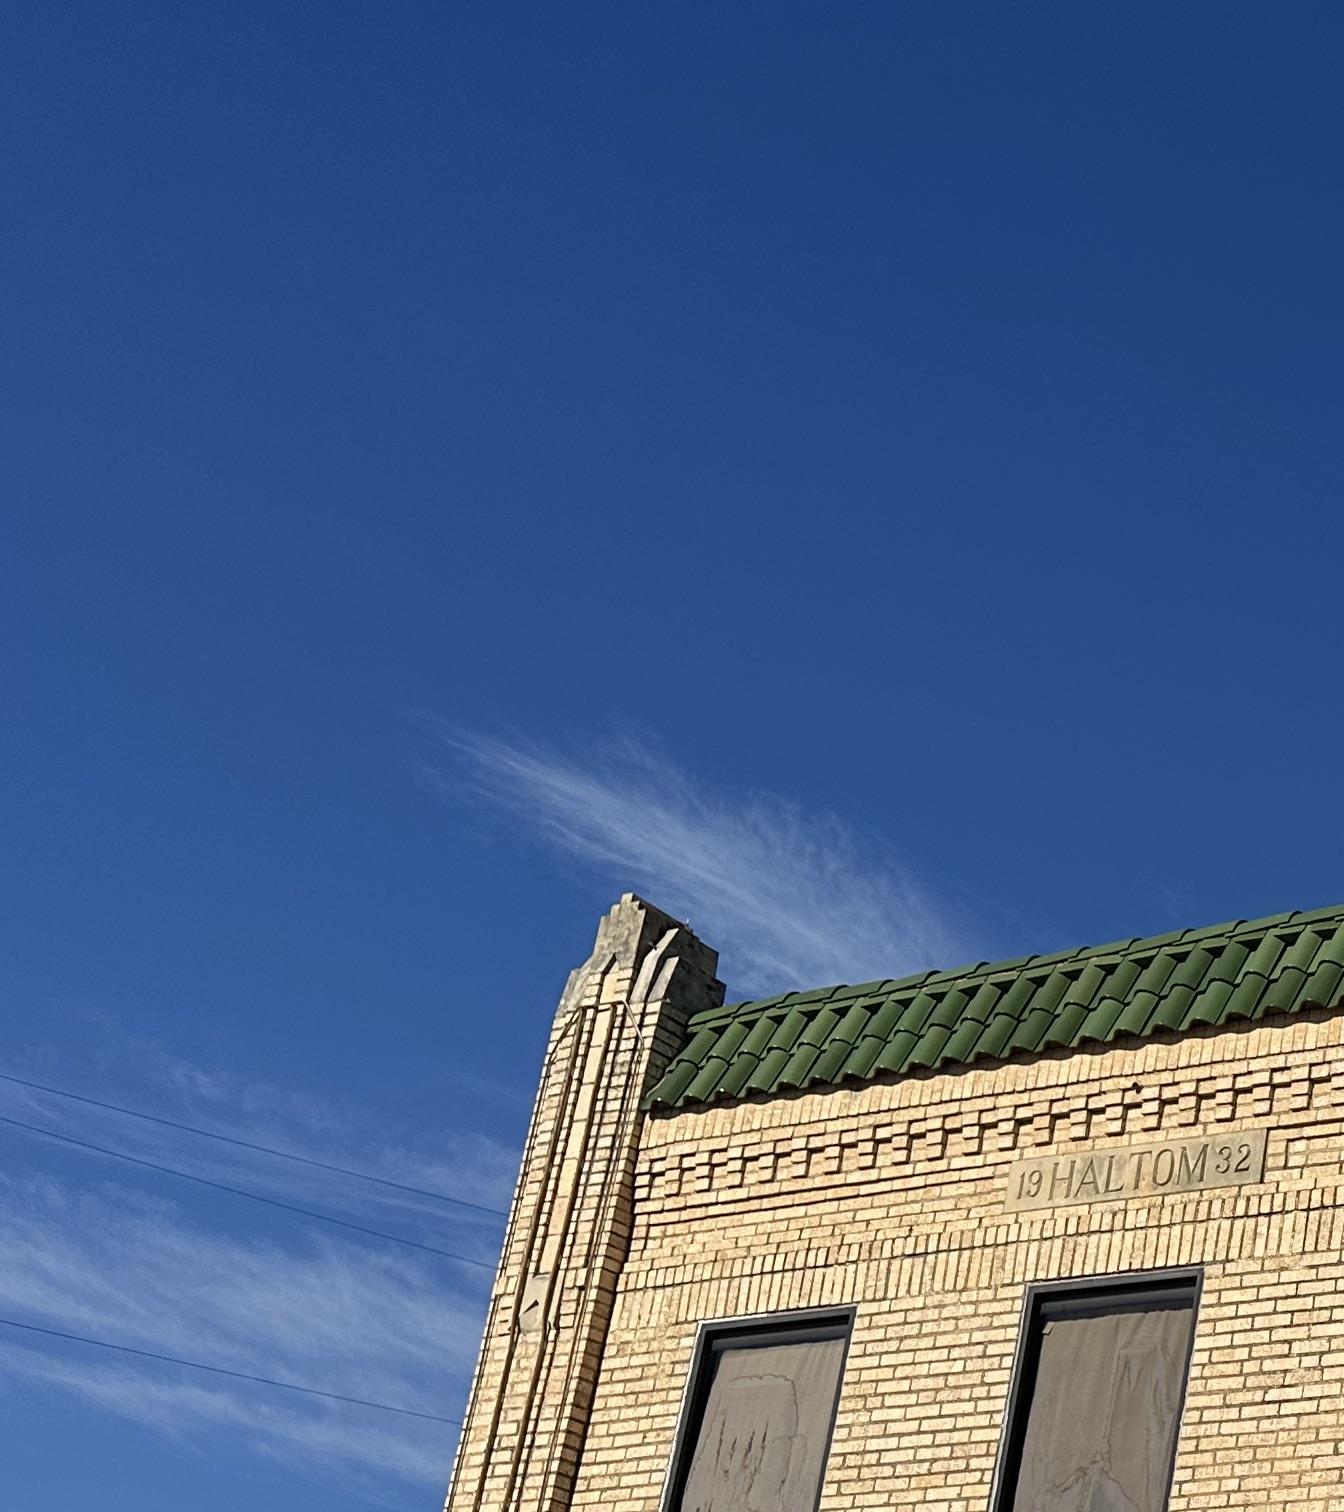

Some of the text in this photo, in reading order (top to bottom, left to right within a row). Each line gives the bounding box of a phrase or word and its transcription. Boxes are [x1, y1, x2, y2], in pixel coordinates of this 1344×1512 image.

[1017, 1143, 1251, 1201] 19 HALTOM 32
